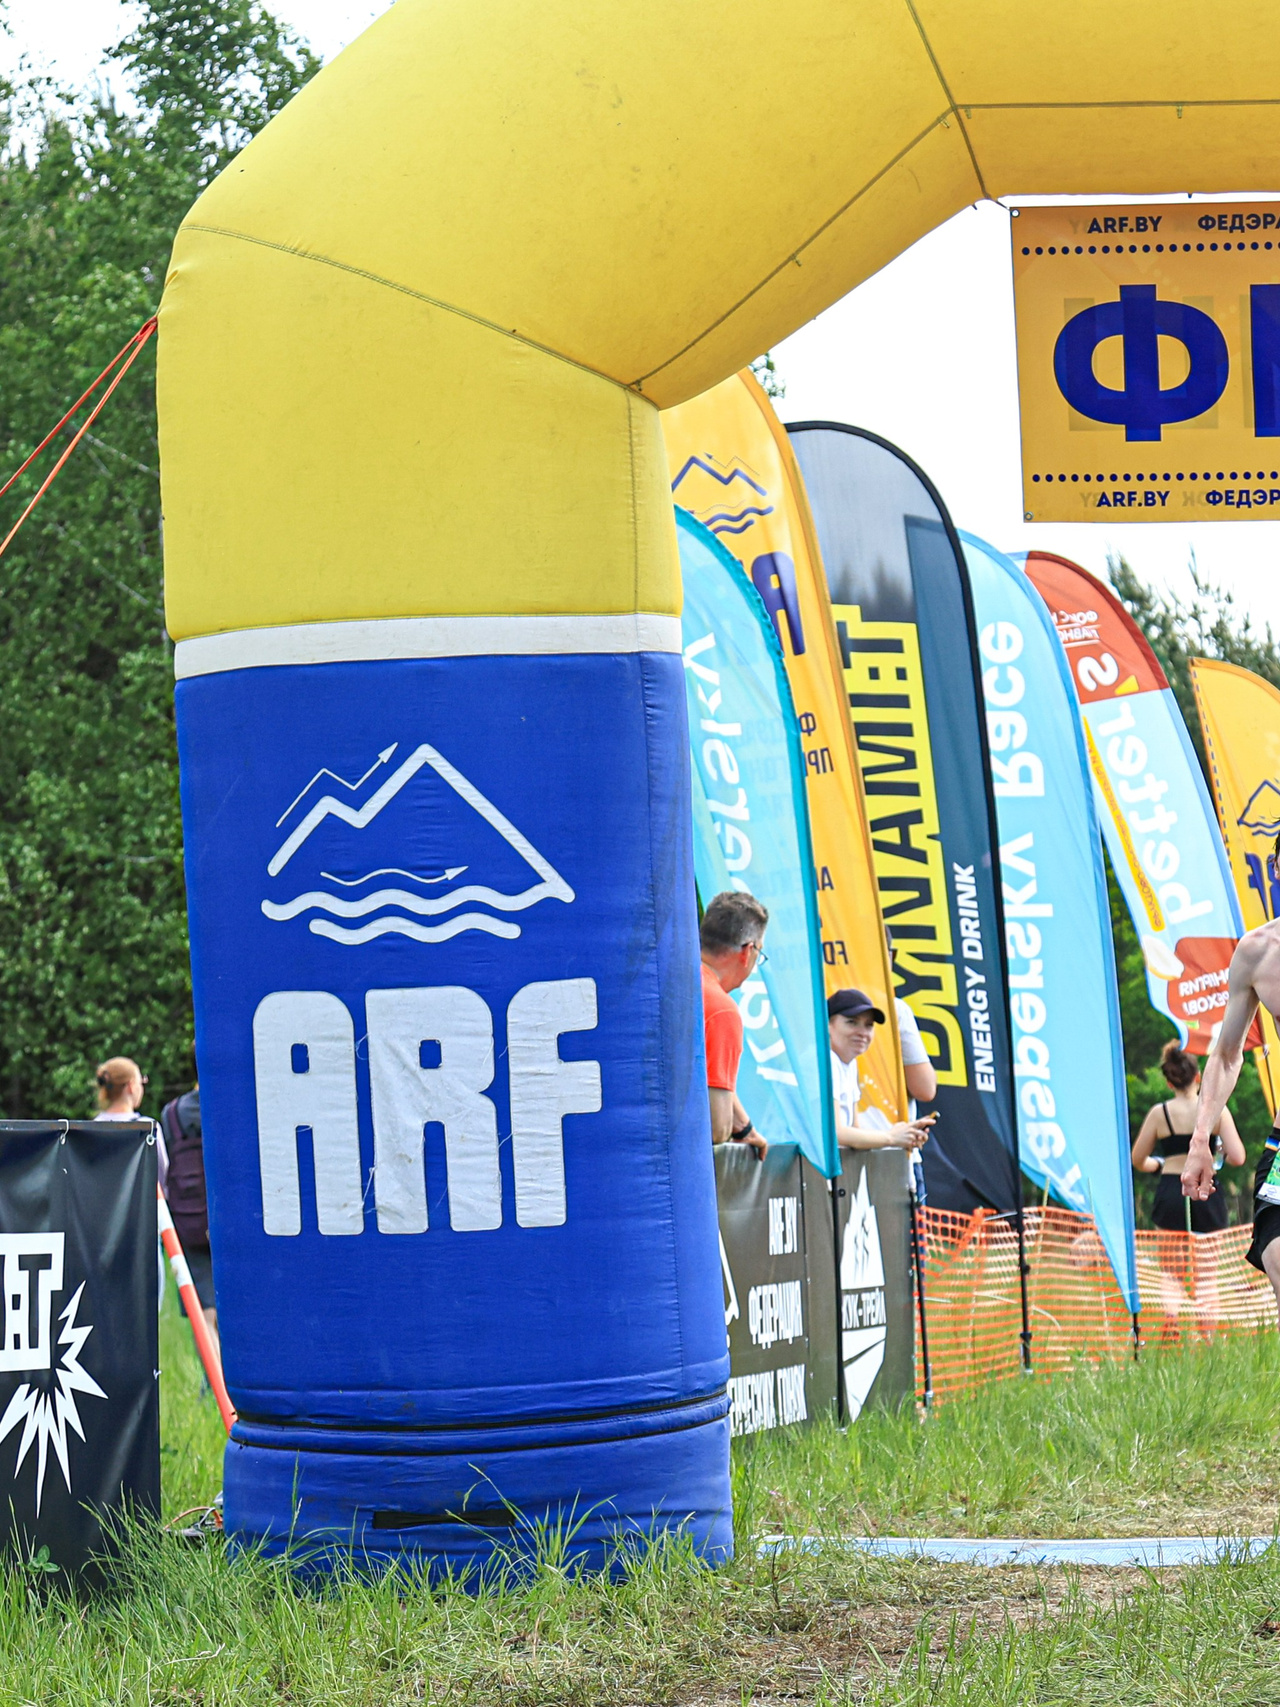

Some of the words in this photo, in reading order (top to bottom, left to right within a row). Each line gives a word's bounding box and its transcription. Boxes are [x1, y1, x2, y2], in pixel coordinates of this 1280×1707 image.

[1087, 215, 1163, 234] ARF.BY
[1096, 490, 1170, 508] ARF.BY
[953, 861, 984, 961] DRINK
[963, 966, 997, 1093] ENERGY
[252, 977, 602, 1236] ARF
